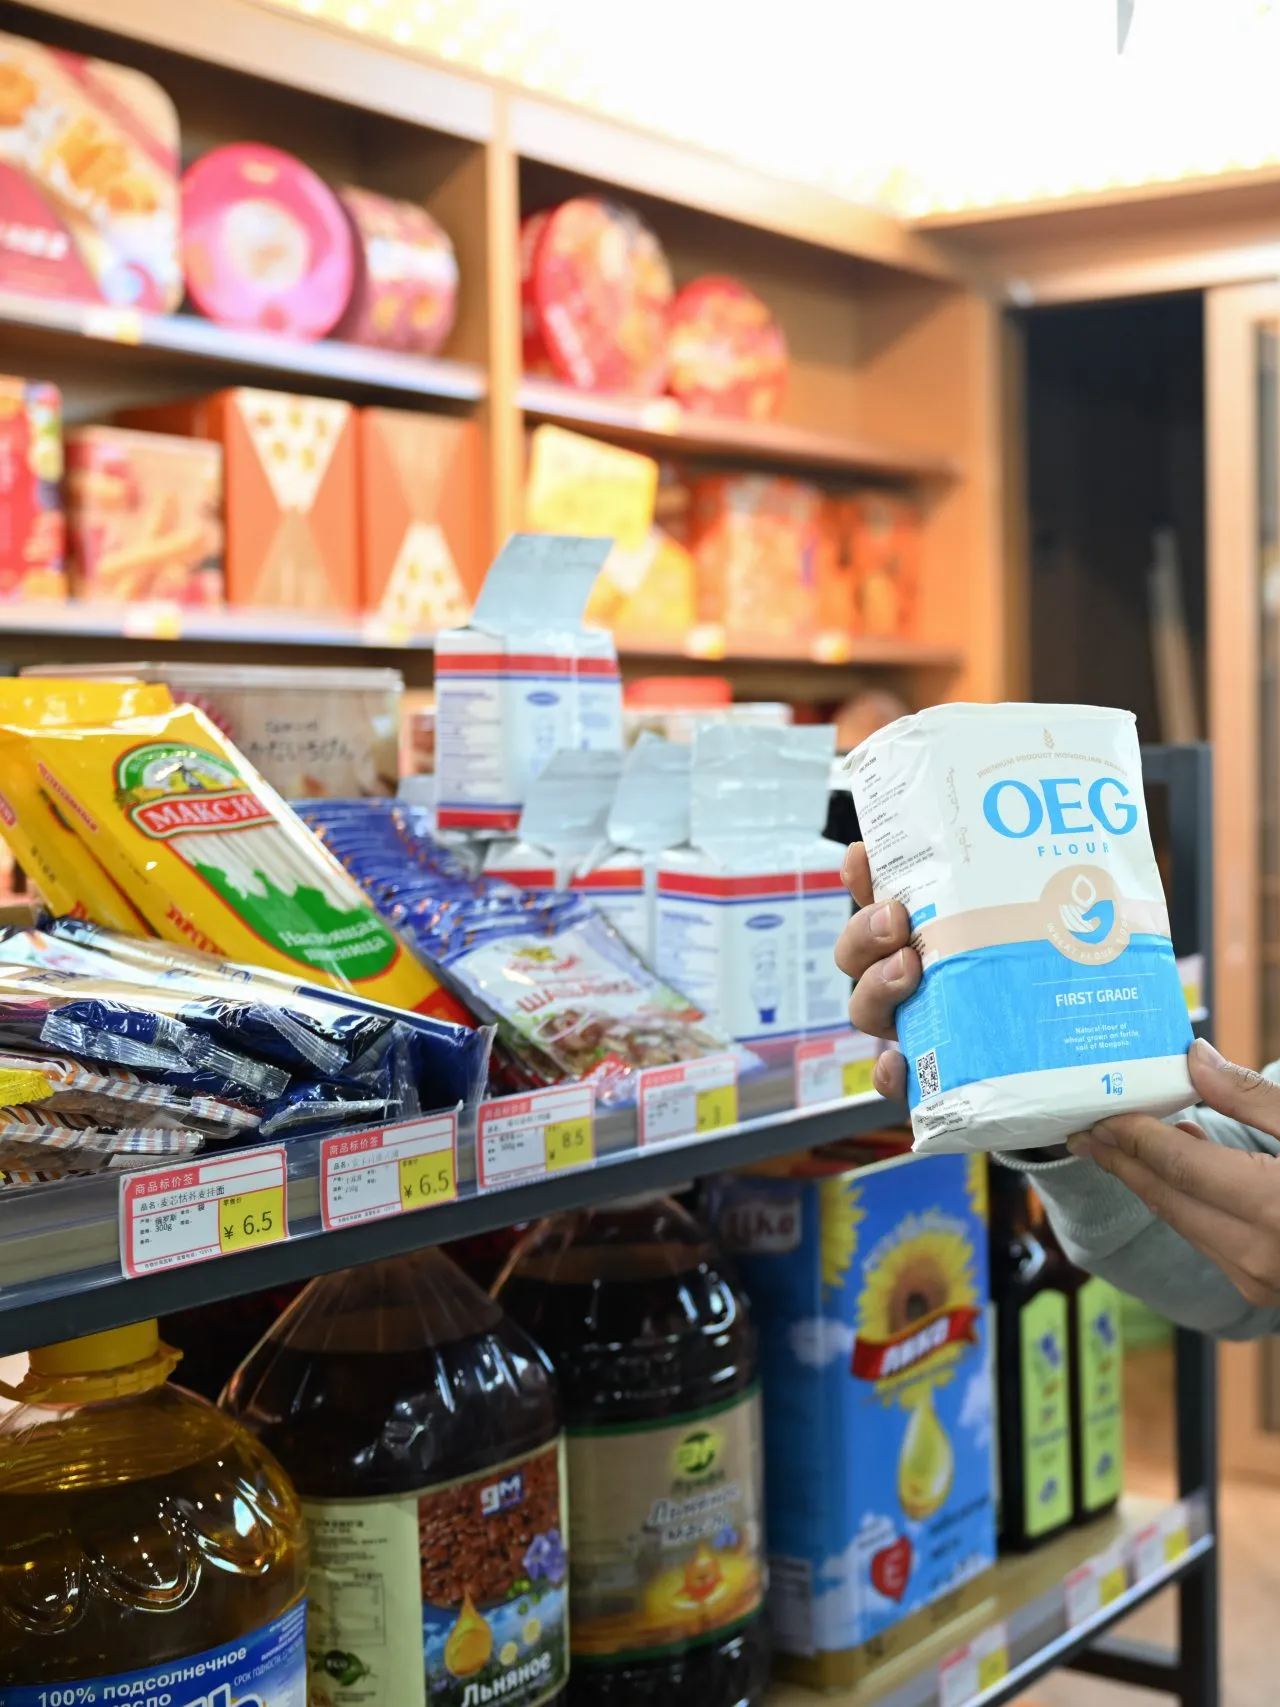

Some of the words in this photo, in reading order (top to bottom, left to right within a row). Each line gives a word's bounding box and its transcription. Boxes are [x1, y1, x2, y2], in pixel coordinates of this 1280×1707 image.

[1016, 752, 1052, 762] PRODUCT
[983, 777, 1138, 839] OEG
[1037, 842, 1109, 857] FLOUR
[1055, 991, 1094, 1007] FIRST
[1096, 987, 1139, 1003] GRADE
[1064, 1035, 1085, 1043] wheat
[1087, 1034, 1108, 1043] grown
[1075, 1025, 1100, 1034] Natural
[1102, 1023, 1118, 1031] flour
[329, 1136, 379, 1156] 商品标价签
[135, 1172, 194, 1196] 商品标价签
[419, 1169, 449, 1196] 6.5
[243, 1210, 273, 1235] 6.5
[38, 1686, 96, 1707] 100%
[103, 1646, 248, 1700] подсолнечное
[233, 1672, 252, 1687] СРОК
[461, 1651, 552, 1707] Льняное
